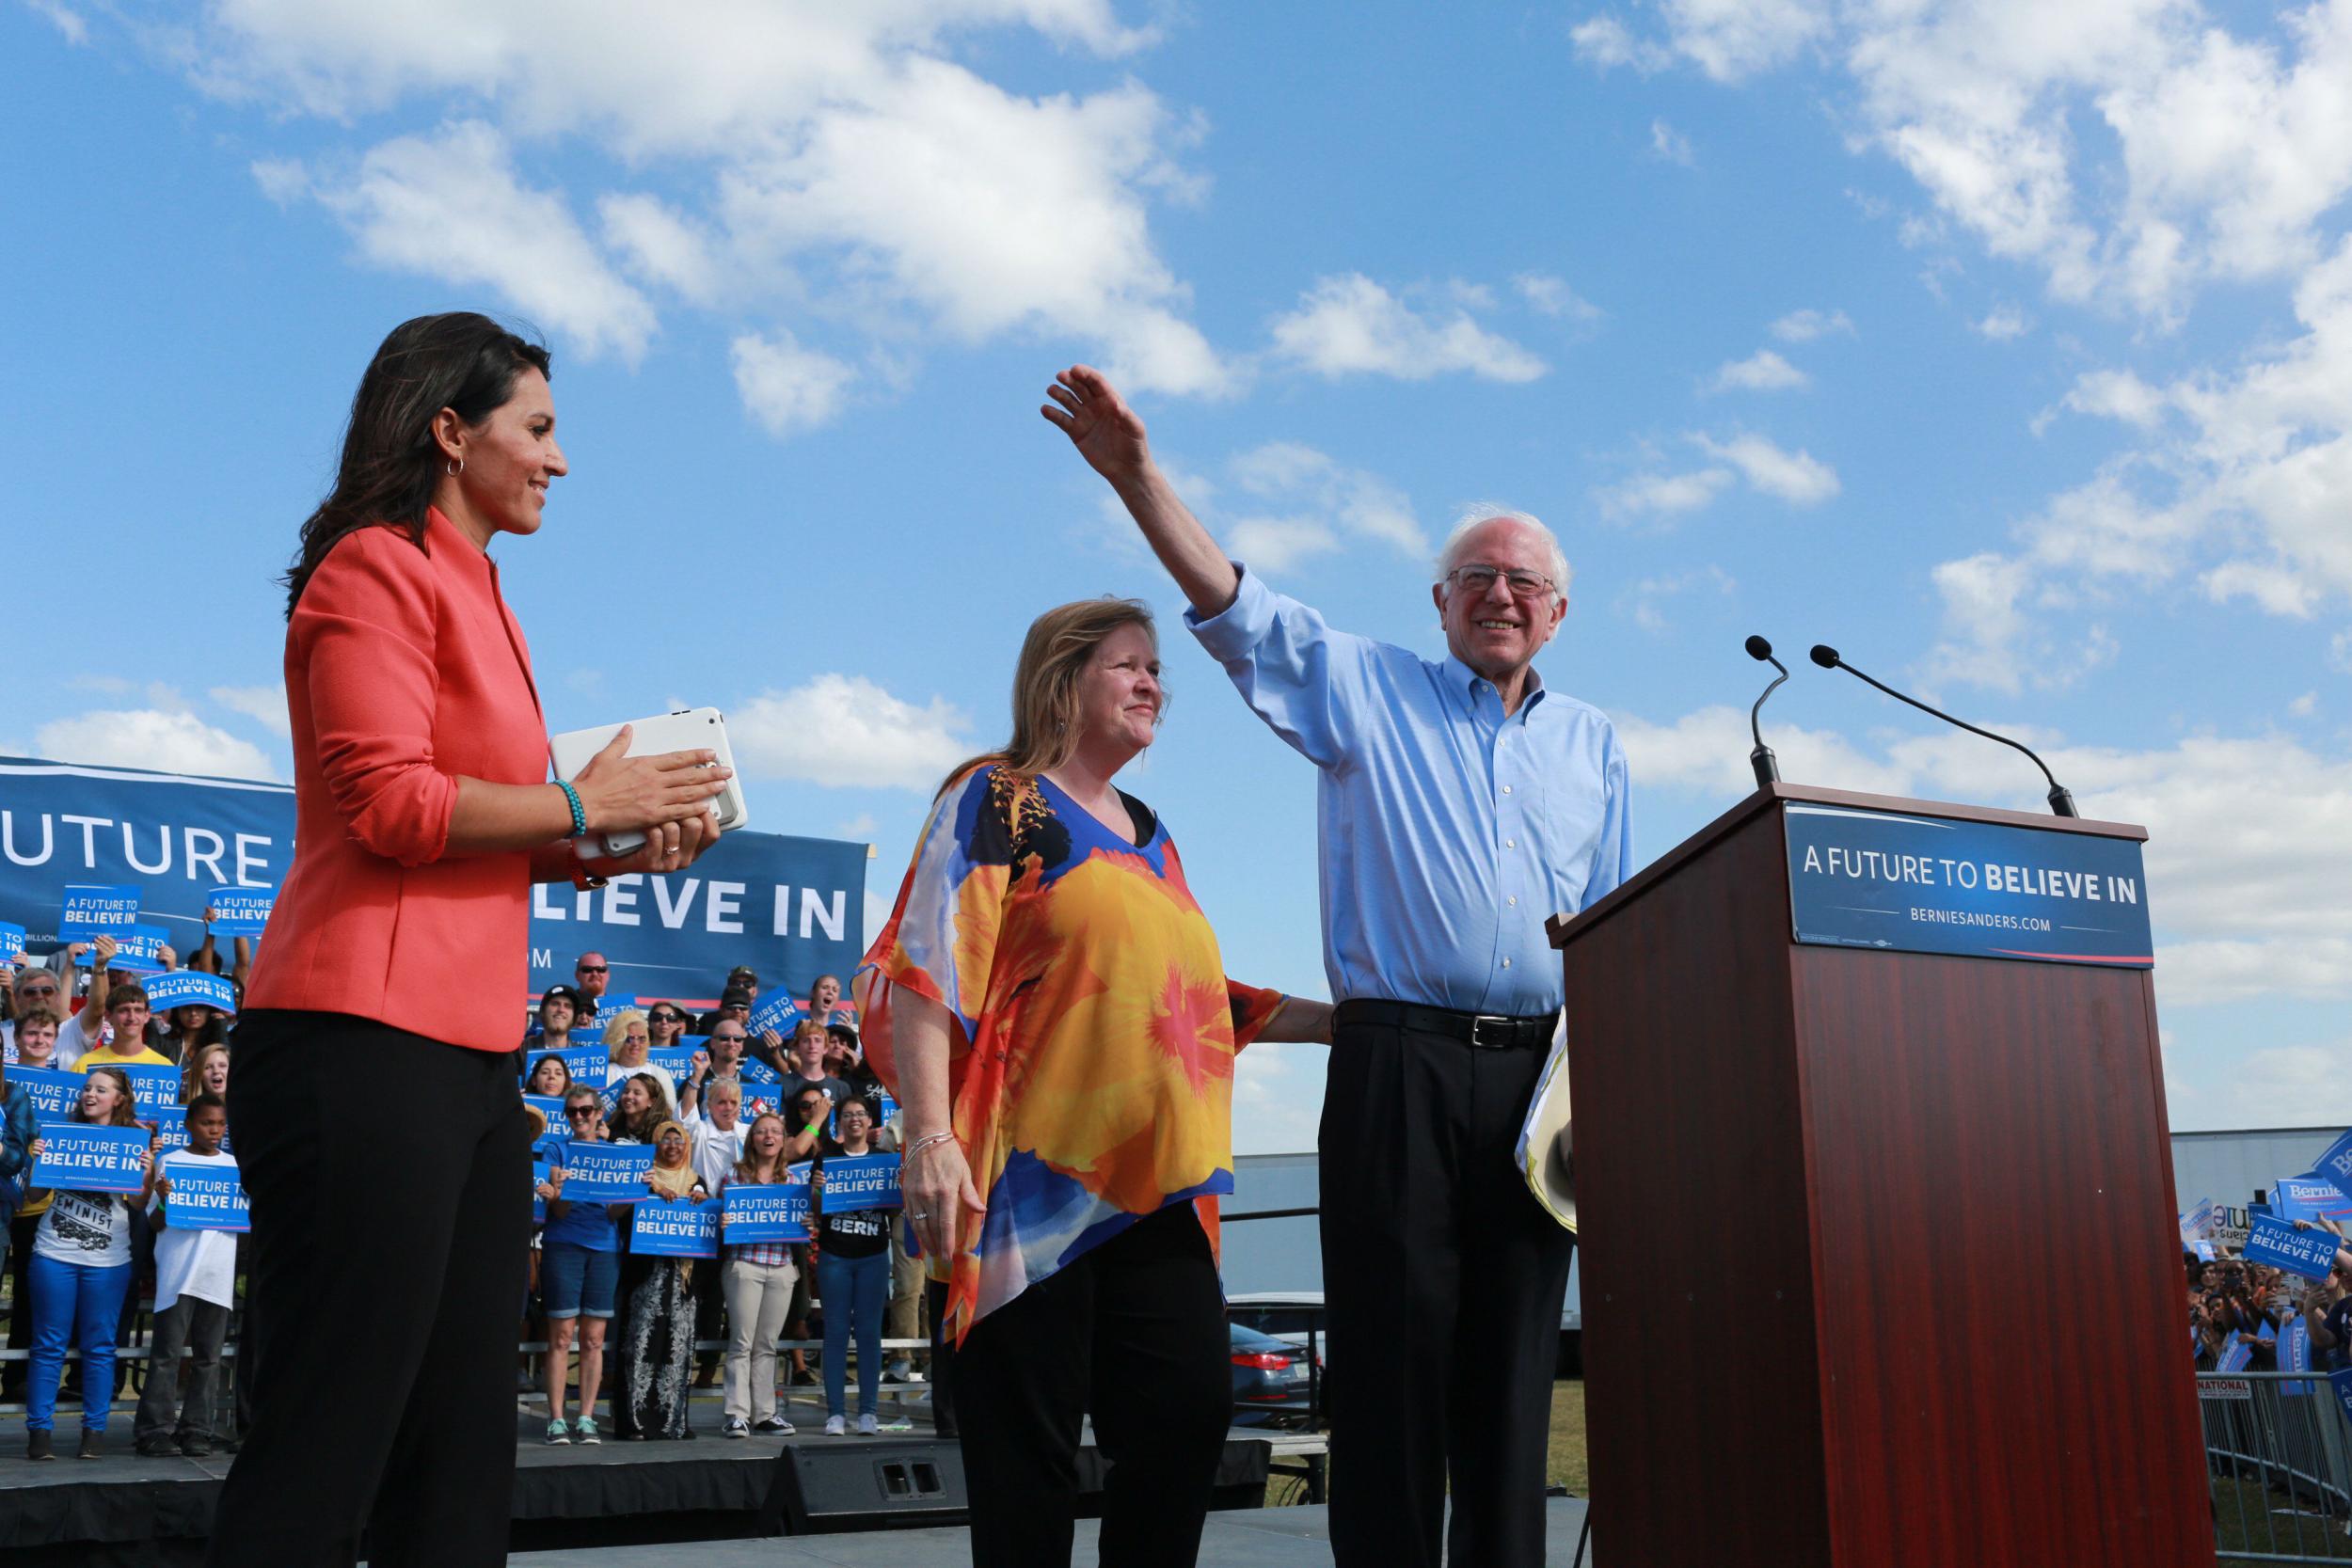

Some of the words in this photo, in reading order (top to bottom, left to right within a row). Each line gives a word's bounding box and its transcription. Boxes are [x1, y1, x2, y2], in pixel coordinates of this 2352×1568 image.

[1, 811, 273, 888] UTURE
[1804, 845, 1823, 874] A
[1828, 847, 1935, 884] FUTURE
[1939, 859, 1978, 889] TO
[1985, 863, 2100, 900] BELIEVE
[2107, 876, 2137, 904] IN
[68, 897, 76, 909] A
[79, 898, 123, 911] FUTURE
[126, 900, 137, 911] TO
[213, 897, 221, 907] A
[224, 897, 273, 909] FUTURE
[532, 873, 746, 934] LIEVE
[773, 884, 846, 942] IN
[65, 911, 123, 924] BELIEVE
[124, 912, 135, 924] IN
[1911, 907, 2051, 932] BERNIESANDERS.COM
[5, 932, 22, 944] TO
[24, 932, 57, 942] BILLION
[147, 937, 165, 948] TO
[6, 941, 22, 952] IN
[147, 983, 157, 991] A
[159, 977, 212, 988] FUTURE
[214, 983, 230, 994] TO
[147, 985, 213, 1000] BELIEVE
[216, 990, 231, 1003] IN
[745, 1005, 776, 1028] UTURE
[773, 996, 789, 1008] TO
[748, 1013, 782, 1037] LIEVE
[781, 1004, 796, 1018] IN
[590, 1055, 605, 1065] TO
[589, 1066, 605, 1076] IN
[760, 1069, 774, 1085] IN
[158, 1080, 177, 1091] TO
[157, 1092, 175, 1105] IN
[163, 1120, 172, 1131] A
[44, 1138, 54, 1149] A
[57, 1138, 119, 1153] FUTURE
[123, 1143, 144, 1156] TO
[40, 1152, 118, 1169] BELIEVE
[121, 1157, 142, 1172] IN
[570, 1155, 580, 1166] A
[583, 1156, 632, 1170] FUTURE
[635, 1159, 650, 1170] TO
[568, 1167, 631, 1183] BELIEVE
[826, 1171, 834, 1180] A
[837, 1167, 885, 1180] FUTURE
[169, 1178, 177, 1190] A
[179, 1179, 230, 1194] FUTURE
[825, 1180, 884, 1195] BELIEVE
[168, 1192, 230, 1209] BELIEVE
[232, 1196, 250, 1211] IN
[728, 1199, 737, 1210] A
[739, 1198, 787, 1210] FUTURE
[790, 1198, 808, 1209] TO
[56, 1195, 113, 1230] EMINIST
[638, 1209, 646, 1219] A
[649, 1209, 697, 1223] FUTURE
[700, 1212, 717, 1224] TO
[728, 1212, 787, 1223] BELIEVE
[2213, 1205, 2249, 1229] nie
[636, 1221, 696, 1237] BELIEVE
[699, 1226, 716, 1239] IN
[830, 1218, 880, 1236] BERN
[2256, 1225, 2265, 1234] A
[2266, 1227, 2314, 1249] FUTURE
[2317, 1243, 2333, 1255] TO
[2251, 1234, 2311, 1260] BELIEVE
[2312, 1253, 2330, 1267] IN
